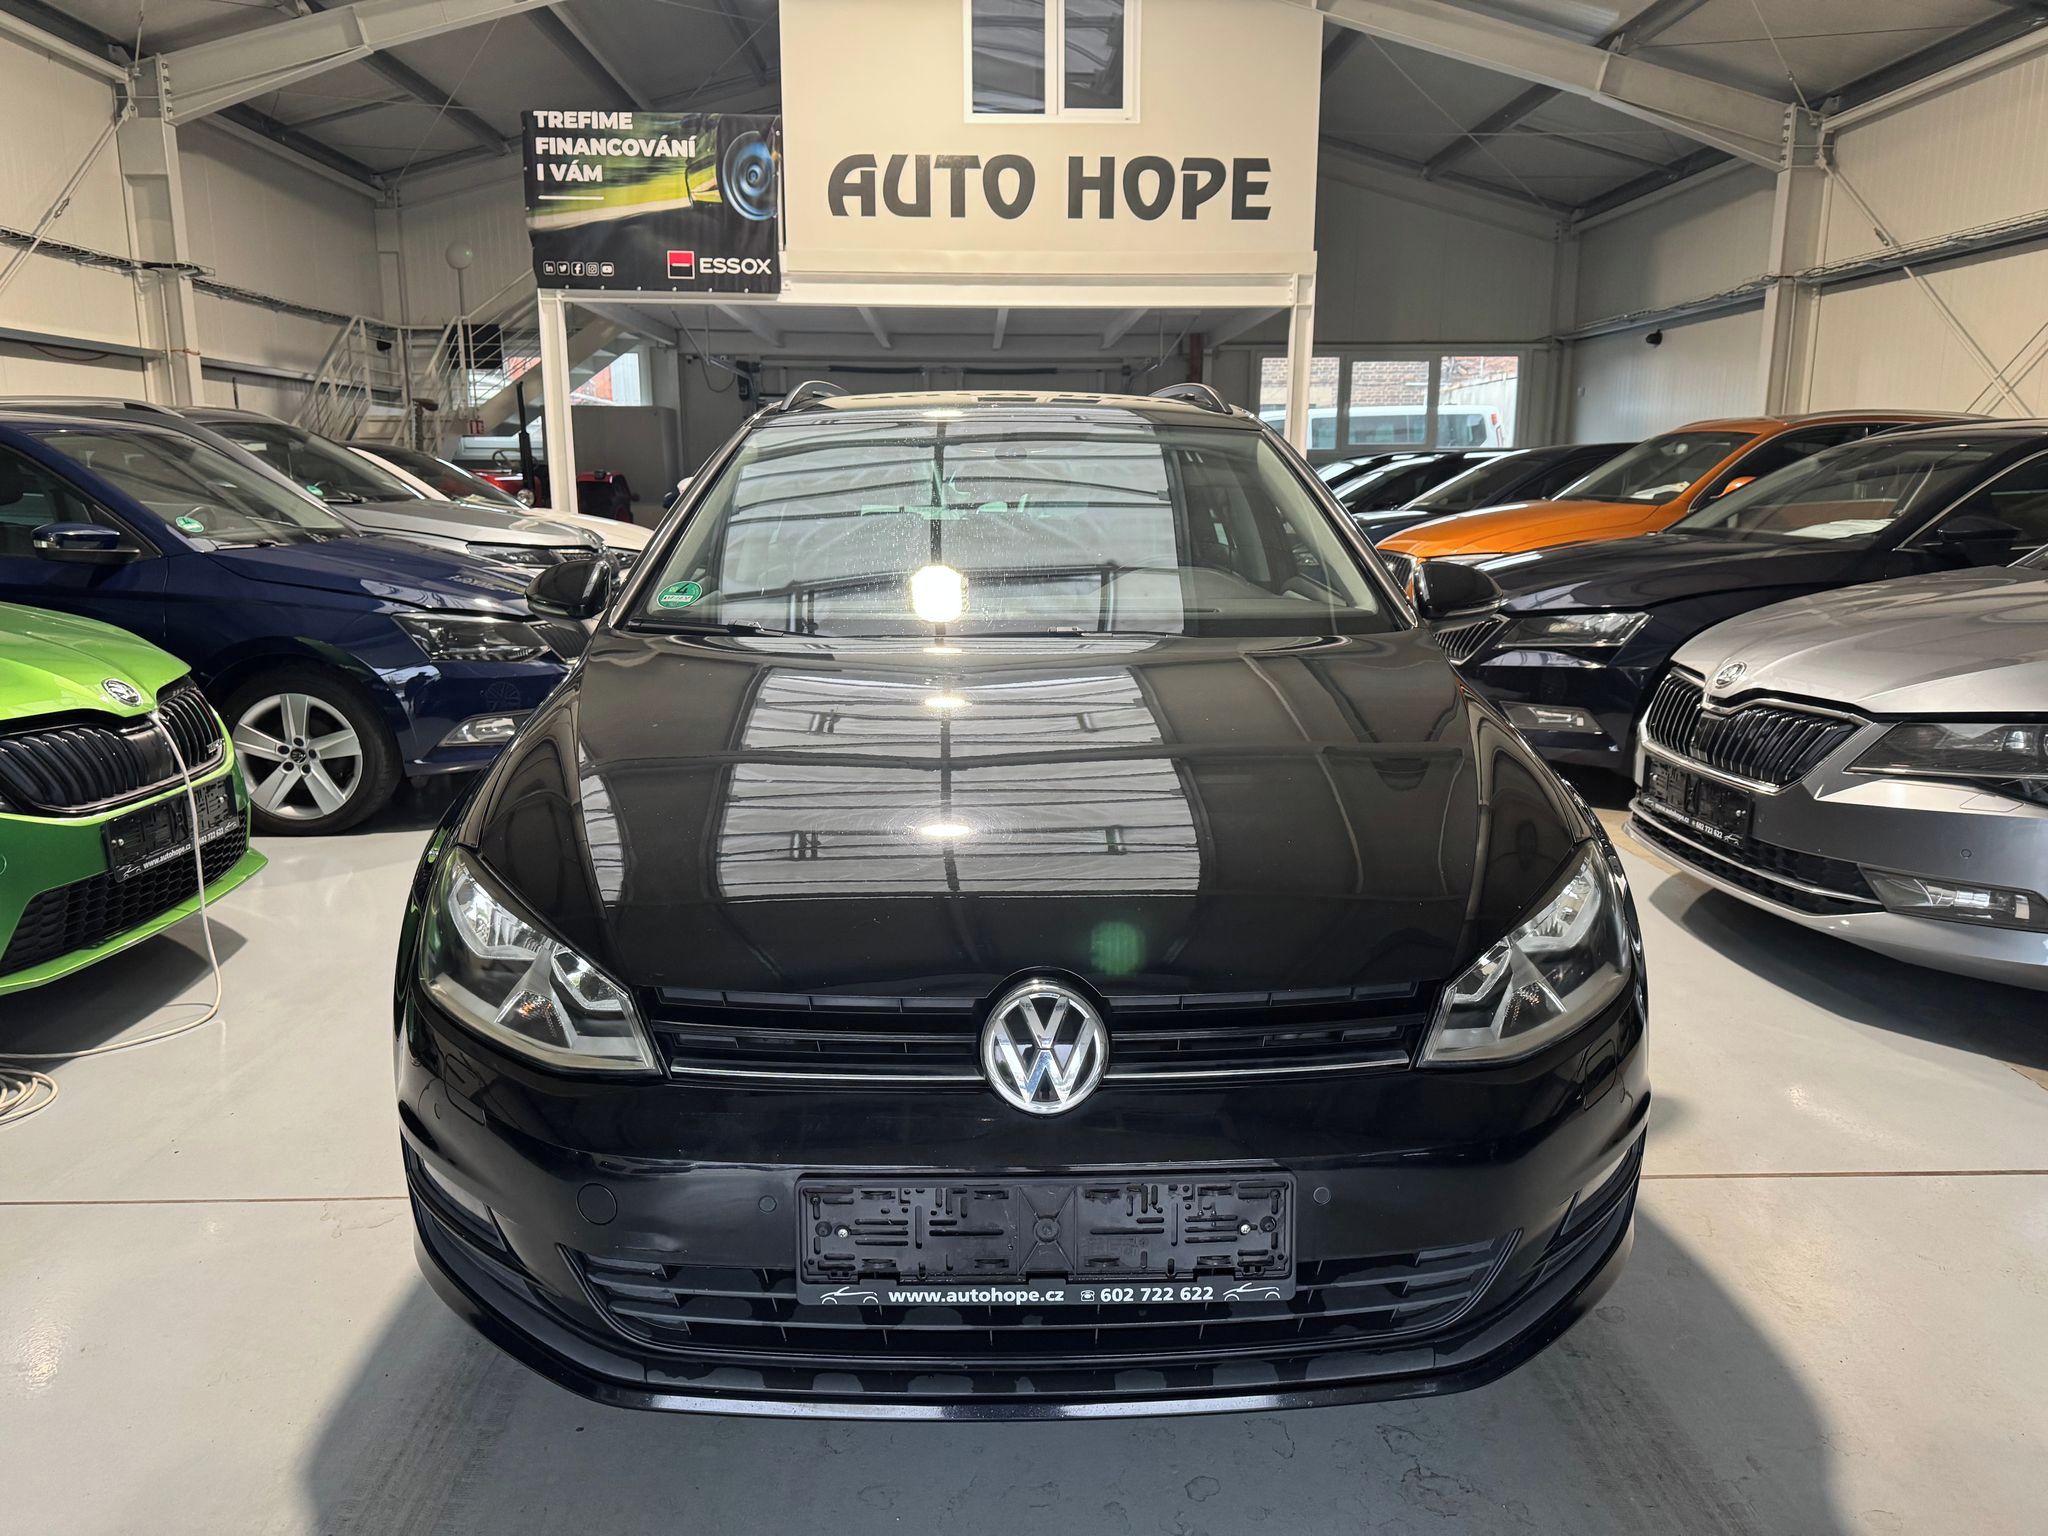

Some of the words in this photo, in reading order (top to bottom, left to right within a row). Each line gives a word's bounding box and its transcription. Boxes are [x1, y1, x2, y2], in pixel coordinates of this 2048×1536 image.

[535, 134, 697, 158] FINANCOVÁNÍ
[536, 163, 544, 182] I
[549, 159, 603, 182] VÁM
[828, 154, 1036, 219] AUTO
[1068, 155, 1272, 221] HOPE
[699, 257, 772, 275] ESSOX
[142, 843, 192, 869] www.autohope.cz
[888, 1288, 1065, 1306] www.autohope.cz
[1100, 1287, 1135, 1303] 602
[1140, 1286, 1174, 1302] 722
[1180, 1286, 1214, 1302] 622
